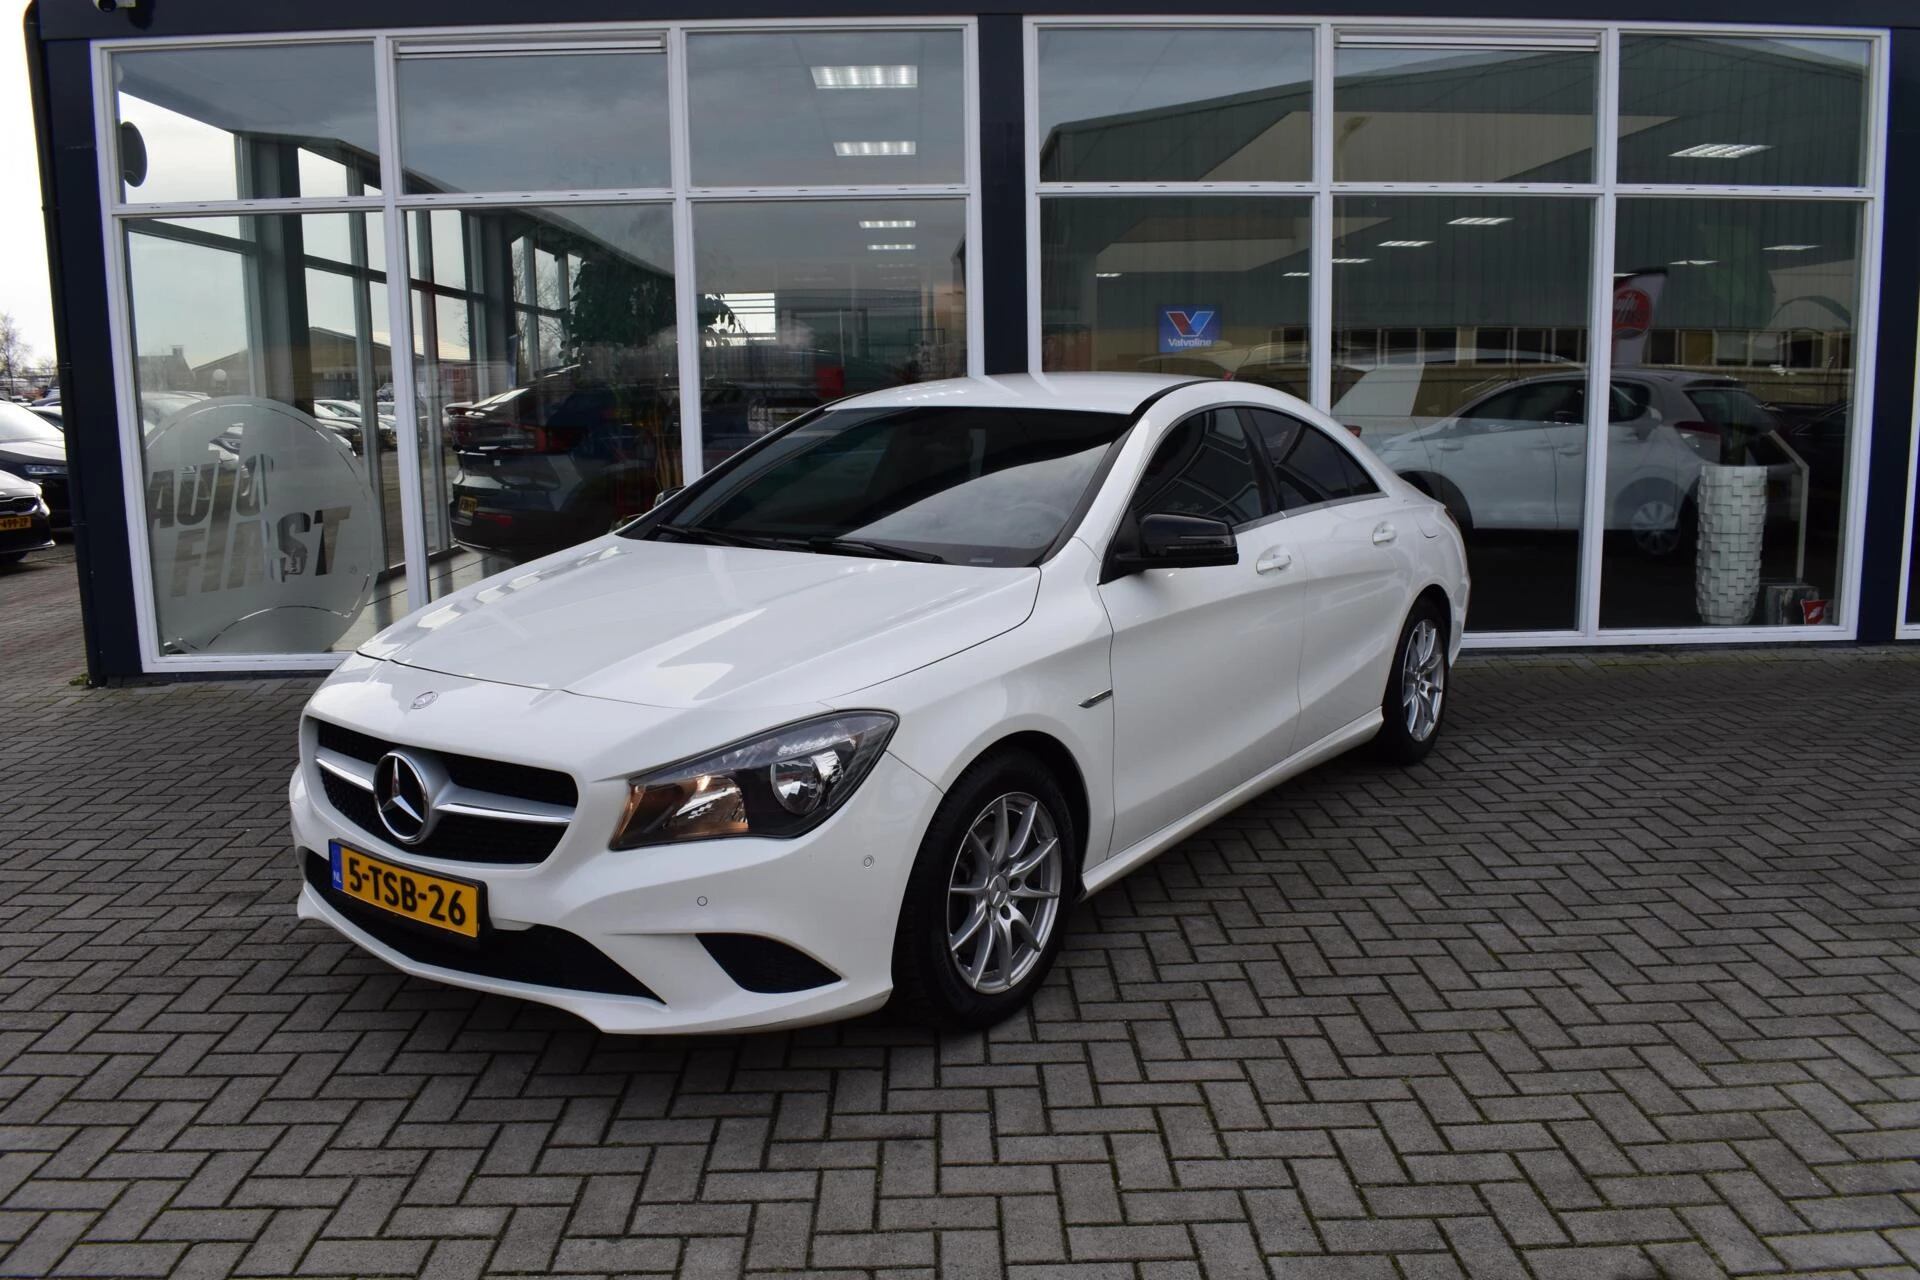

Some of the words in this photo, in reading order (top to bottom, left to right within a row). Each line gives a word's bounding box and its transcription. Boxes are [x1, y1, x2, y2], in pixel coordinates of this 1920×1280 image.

[1167, 338, 1213, 347] Valvoline
[170, 505, 352, 598] FIRST
[332, 870, 343, 884] NL
[348, 857, 467, 927] 5-TSB-26
